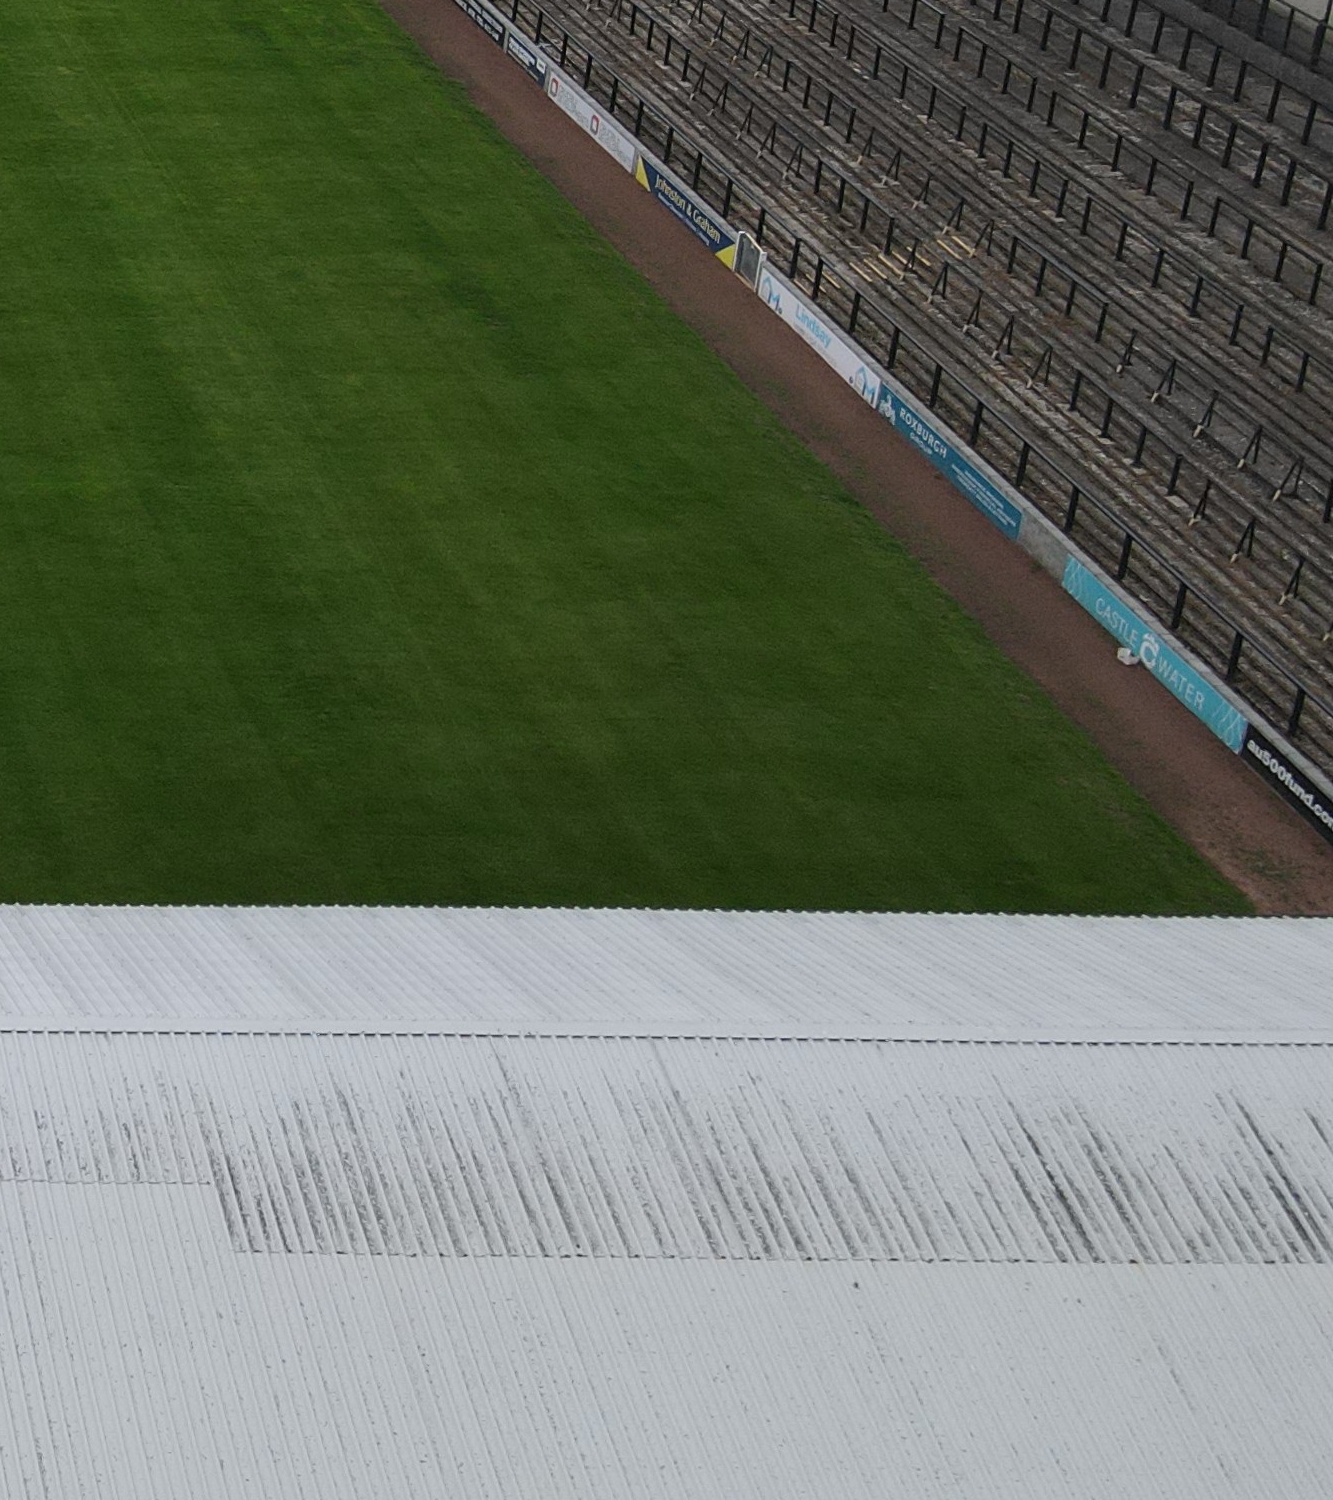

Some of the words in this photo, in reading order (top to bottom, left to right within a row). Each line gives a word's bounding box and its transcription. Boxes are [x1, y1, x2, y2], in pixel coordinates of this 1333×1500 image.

[654, 174, 686, 211] Johnston
[693, 209, 721, 245] Graham
[795, 303, 832, 349] Lindsay
[899, 406, 948, 459] ROXBURGH
[1095, 597, 1140, 650] CASTLE
[1157, 656, 1206, 712] WATER
